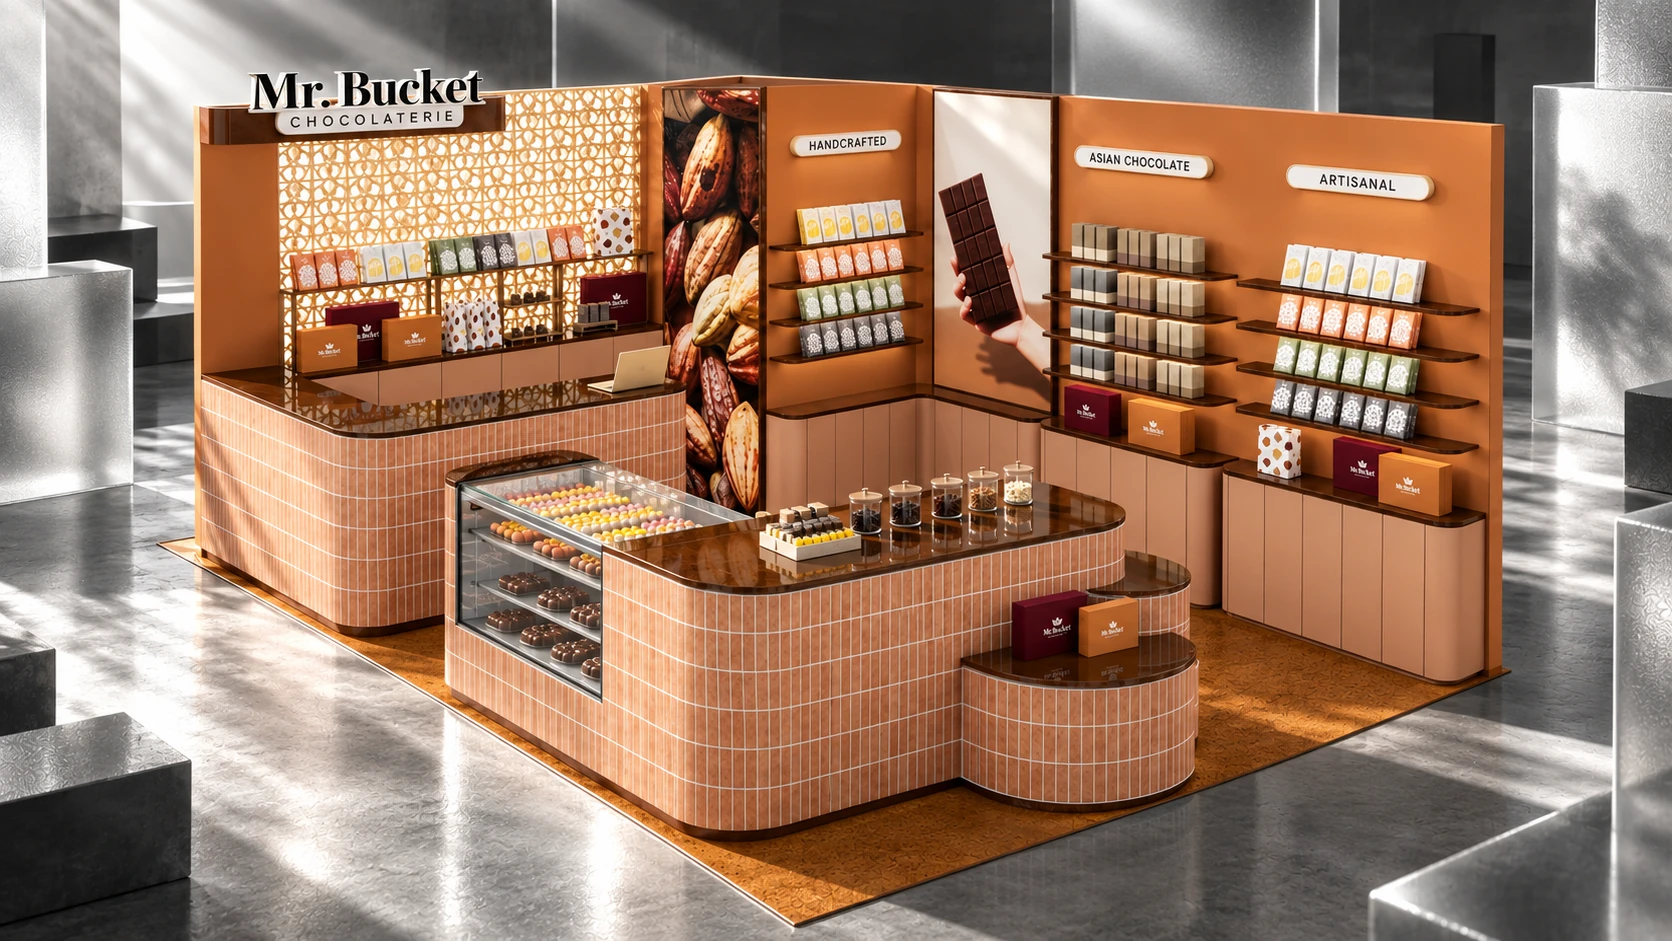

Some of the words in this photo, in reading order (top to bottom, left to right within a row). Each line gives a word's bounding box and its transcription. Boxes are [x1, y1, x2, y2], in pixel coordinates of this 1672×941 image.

[252, 72, 330, 109] Mr.
[340, 69, 484, 107] Bucket
[290, 110, 453, 128] CHOCOLATERIE
[809, 135, 887, 151] HANDCRAFTED
[1089, 152, 1121, 165] ASIAN
[1124, 155, 1190, 172] CHOCOLATE
[1319, 173, 1396, 192] ARTISANAL
